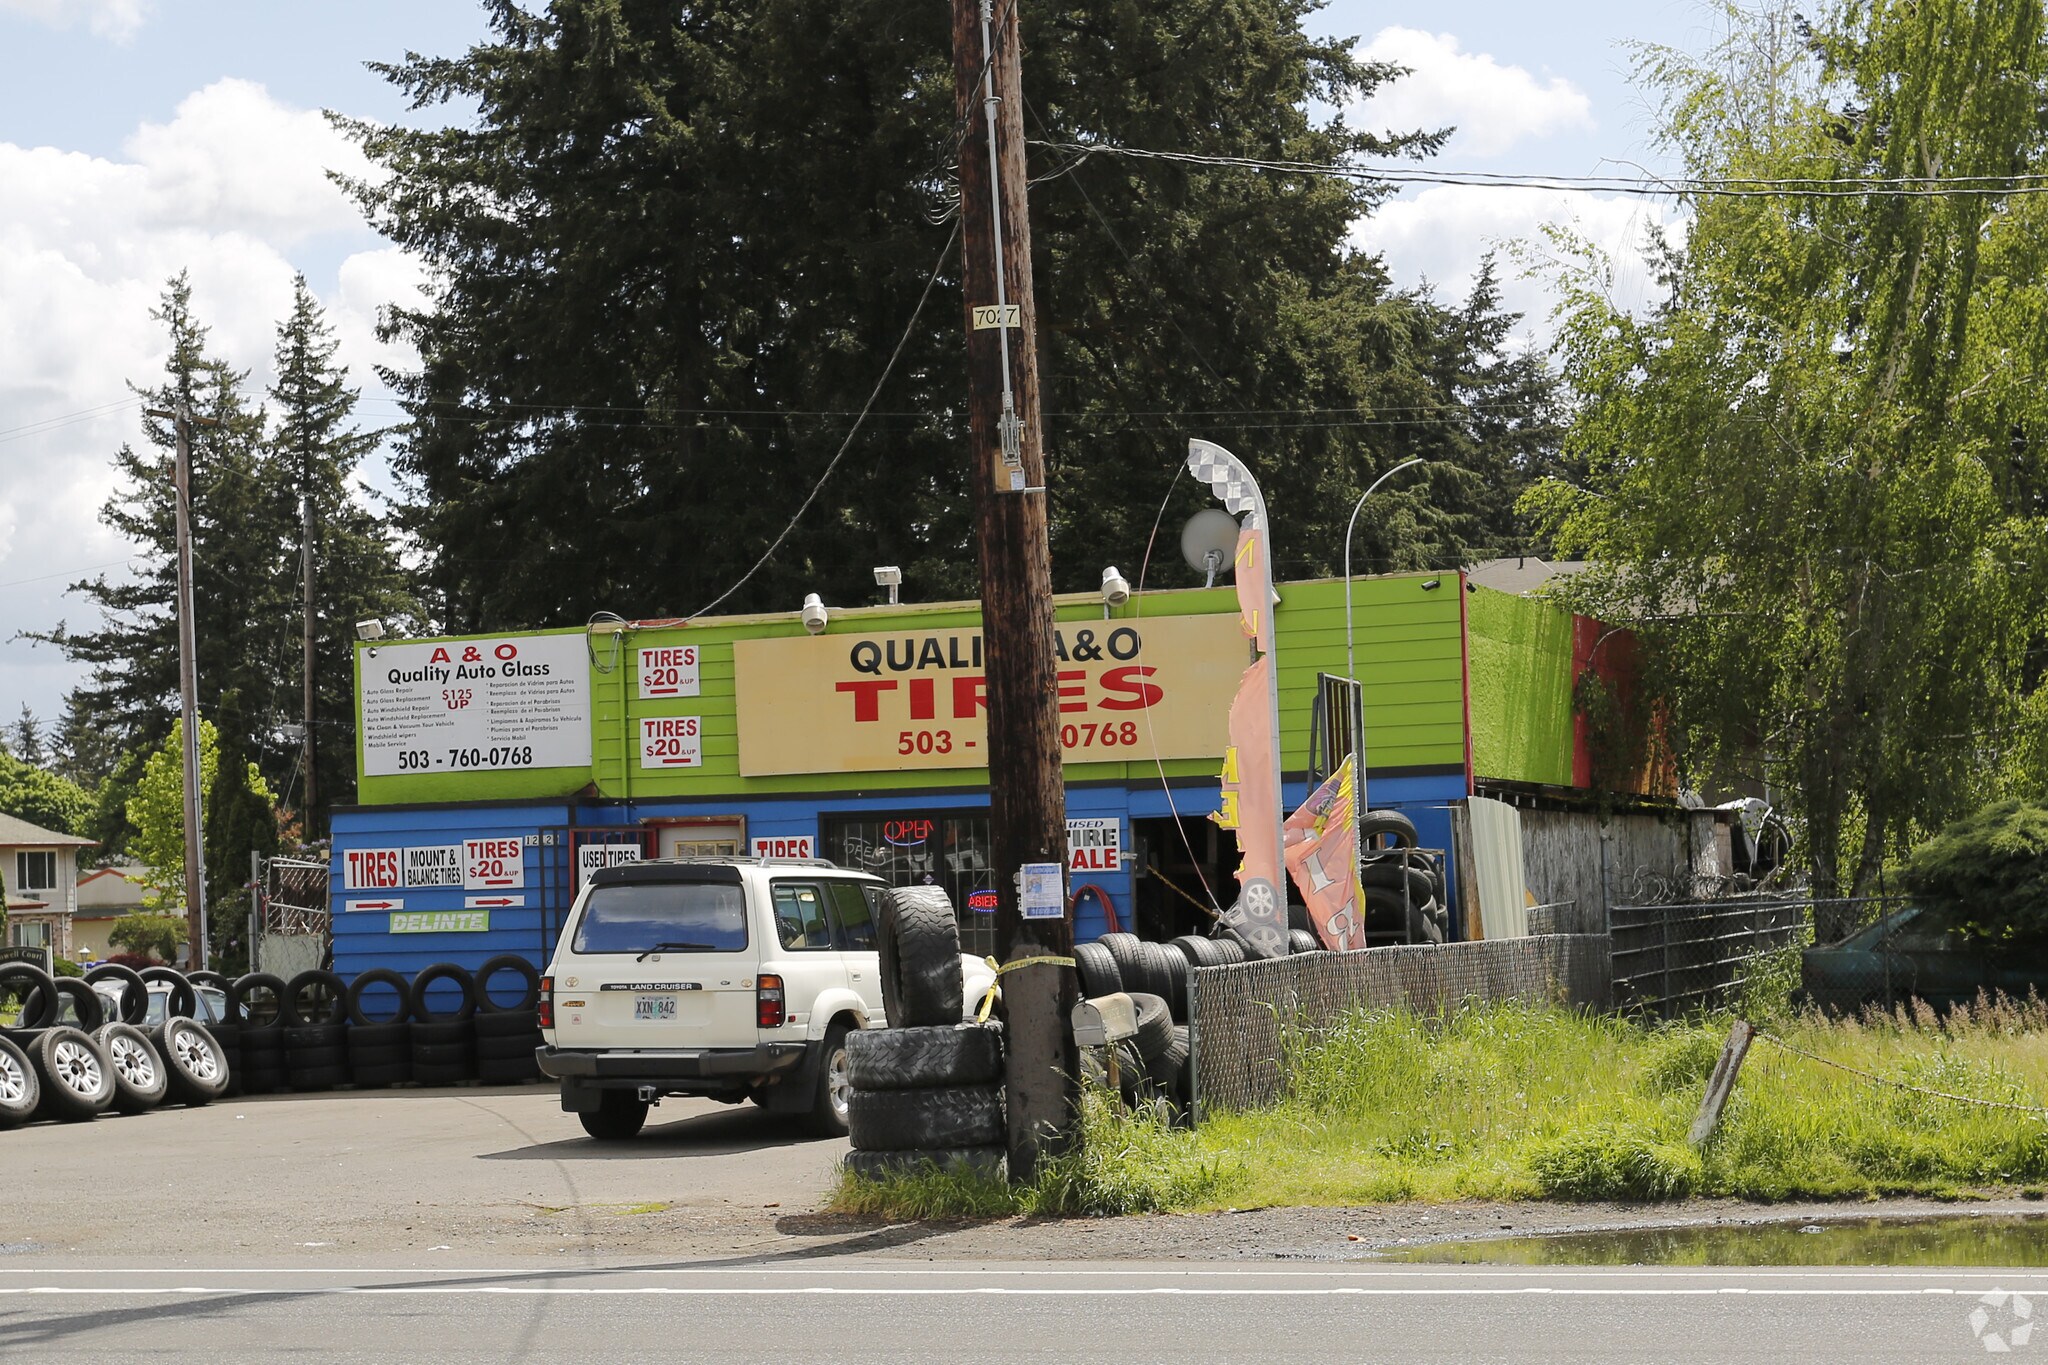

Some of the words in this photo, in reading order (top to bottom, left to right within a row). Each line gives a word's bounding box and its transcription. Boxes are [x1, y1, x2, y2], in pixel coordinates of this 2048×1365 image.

[430, 648, 451, 663] A
[462, 646, 483, 662] &
[494, 644, 518, 661] O
[642, 648, 695, 668] TIRES
[850, 636, 982, 675] QUALI
[388, 665, 450, 684] Quality
[456, 664, 496, 680] Auto
[502, 661, 550, 677] Glass
[644, 668, 678, 687] $20
[396, 695, 431, 703] Replacement
[442, 688, 473, 701] $125
[447, 700, 470, 710] UP
[411, 713, 446, 721] Replacement
[644, 719, 697, 738] TIRES
[646, 738, 680, 757] $20
[898, 730, 953, 755] 503
[398, 750, 430, 769] 503
[449, 746, 533, 768] 760-0768
[1068, 820, 1104, 829] USED
[410, 850, 445, 867] MOUNT
[449, 848, 456, 865] &
[467, 840, 519, 860] TIRES
[583, 850, 605, 868] USED
[1069, 848, 1118, 869] ALE
[349, 851, 398, 887] TIRES
[408, 868, 439, 886] BALANCE
[440, 867, 460, 884] TIRES
[469, 860, 503, 878] $20
[968, 895, 998, 908] ABIER
[393, 913, 485, 931] DELINTE
[21, 950, 43, 961] Court
[636, 1001, 653, 1014] XXN
[658, 1001, 675, 1014] 842
